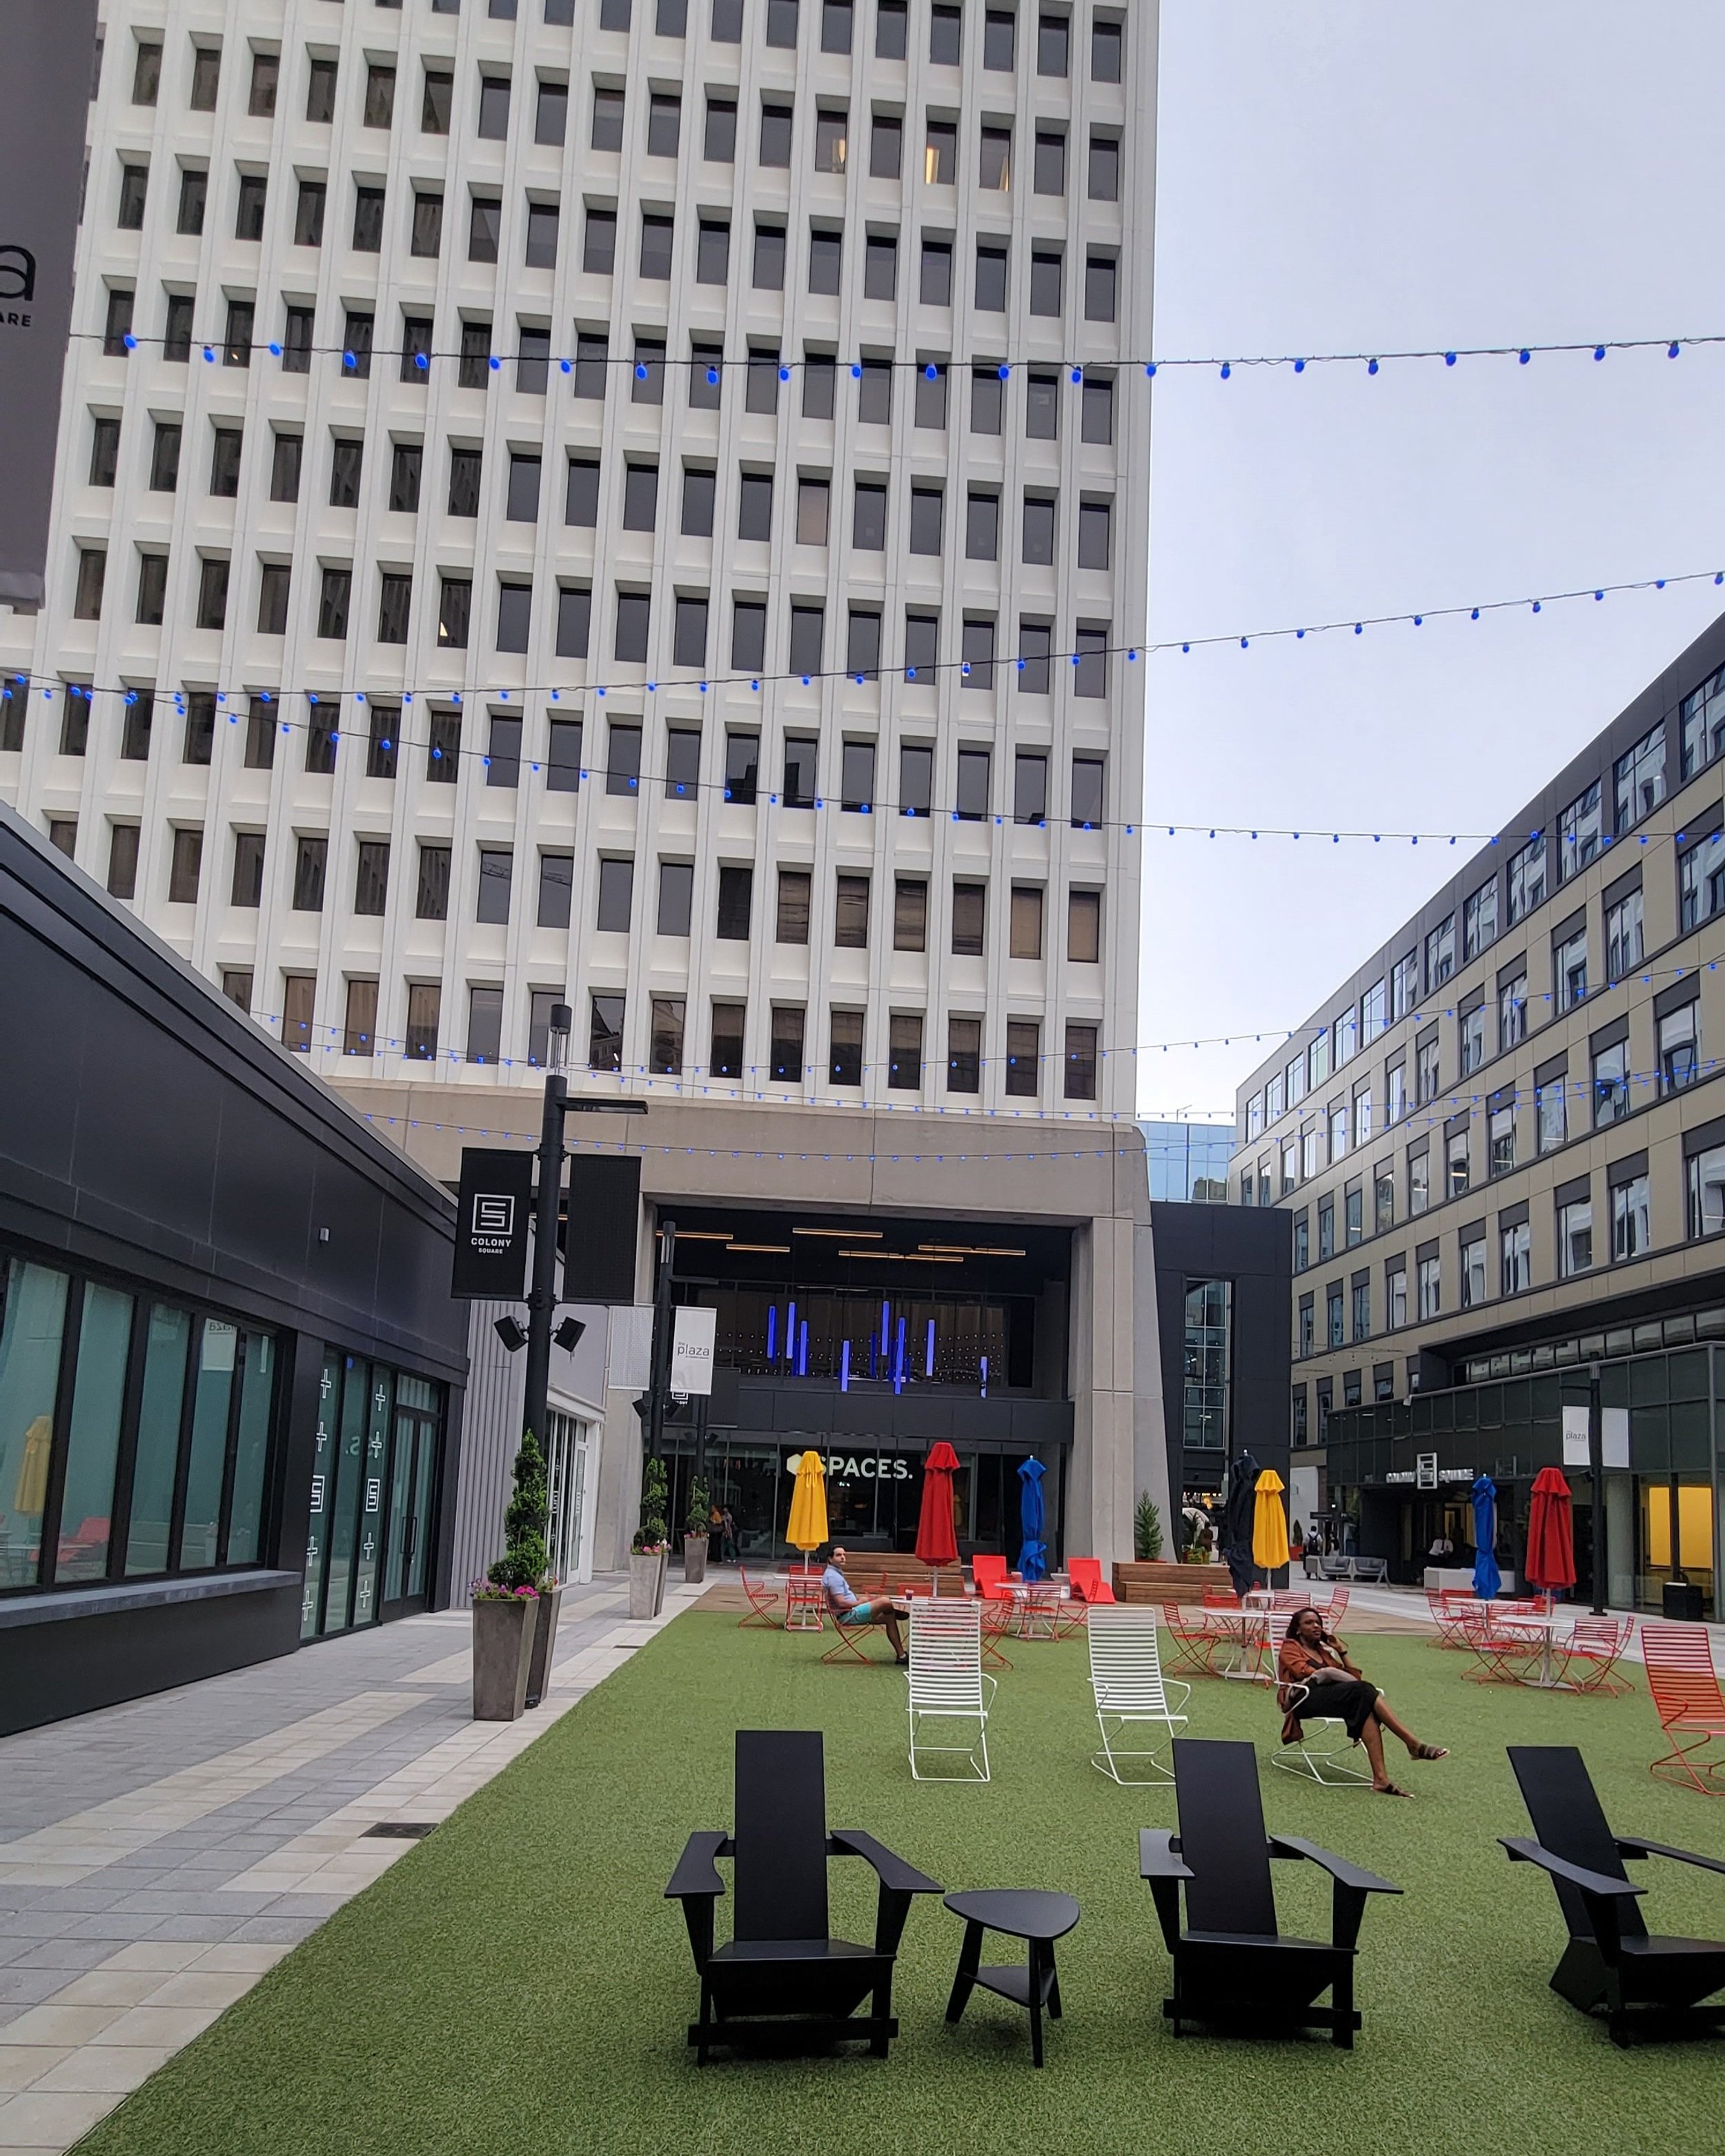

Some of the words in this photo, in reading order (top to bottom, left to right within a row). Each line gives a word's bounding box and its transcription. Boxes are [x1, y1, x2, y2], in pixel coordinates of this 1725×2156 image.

[471, 1237, 512, 1247] COLONY
[678, 1344, 709, 1356] plaza
[1566, 1432, 1586, 1441] plaza
